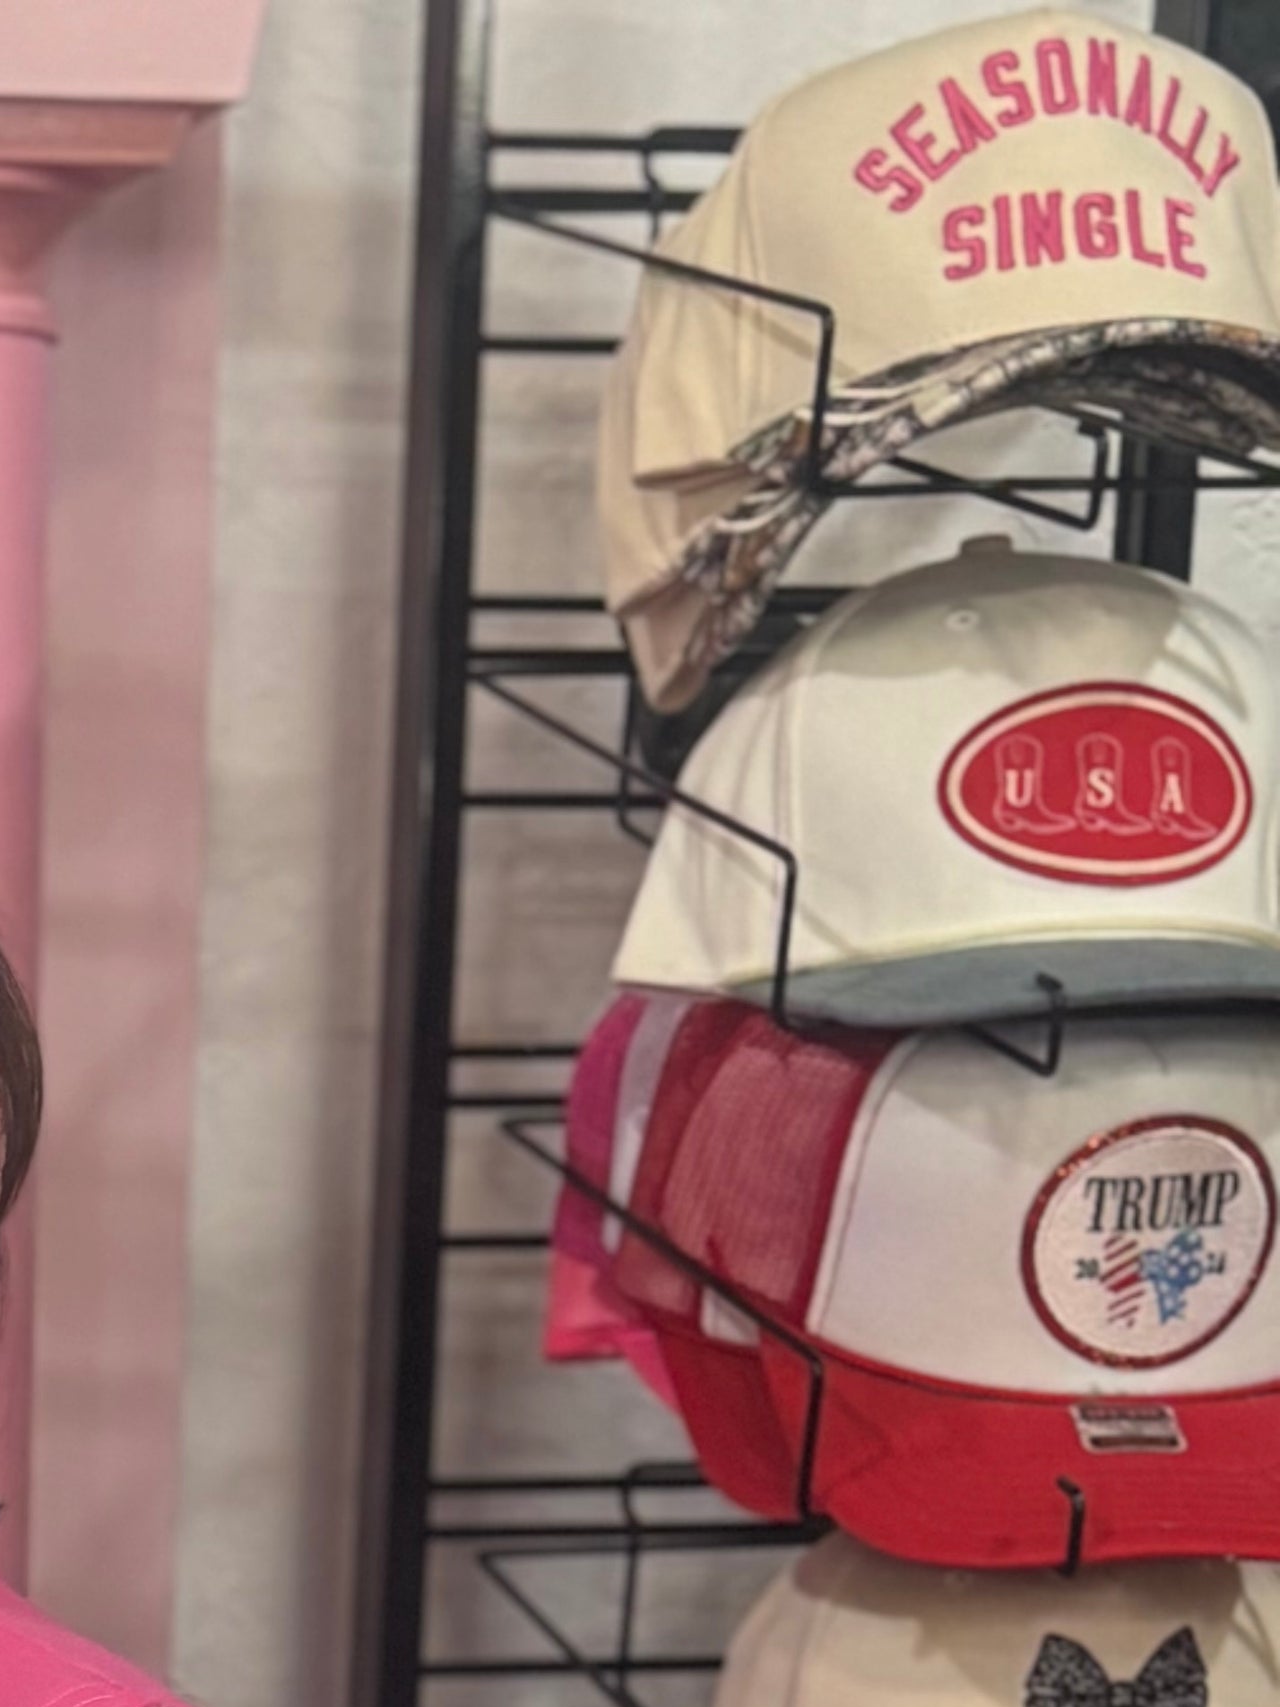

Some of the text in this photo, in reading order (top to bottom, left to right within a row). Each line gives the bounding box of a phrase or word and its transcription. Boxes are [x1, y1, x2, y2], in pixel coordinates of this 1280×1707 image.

[854, 37, 1240, 213] SEASONALLY
[942, 188, 1208, 281] SINGLE
[1084, 1169, 1241, 1233] TRUMP
